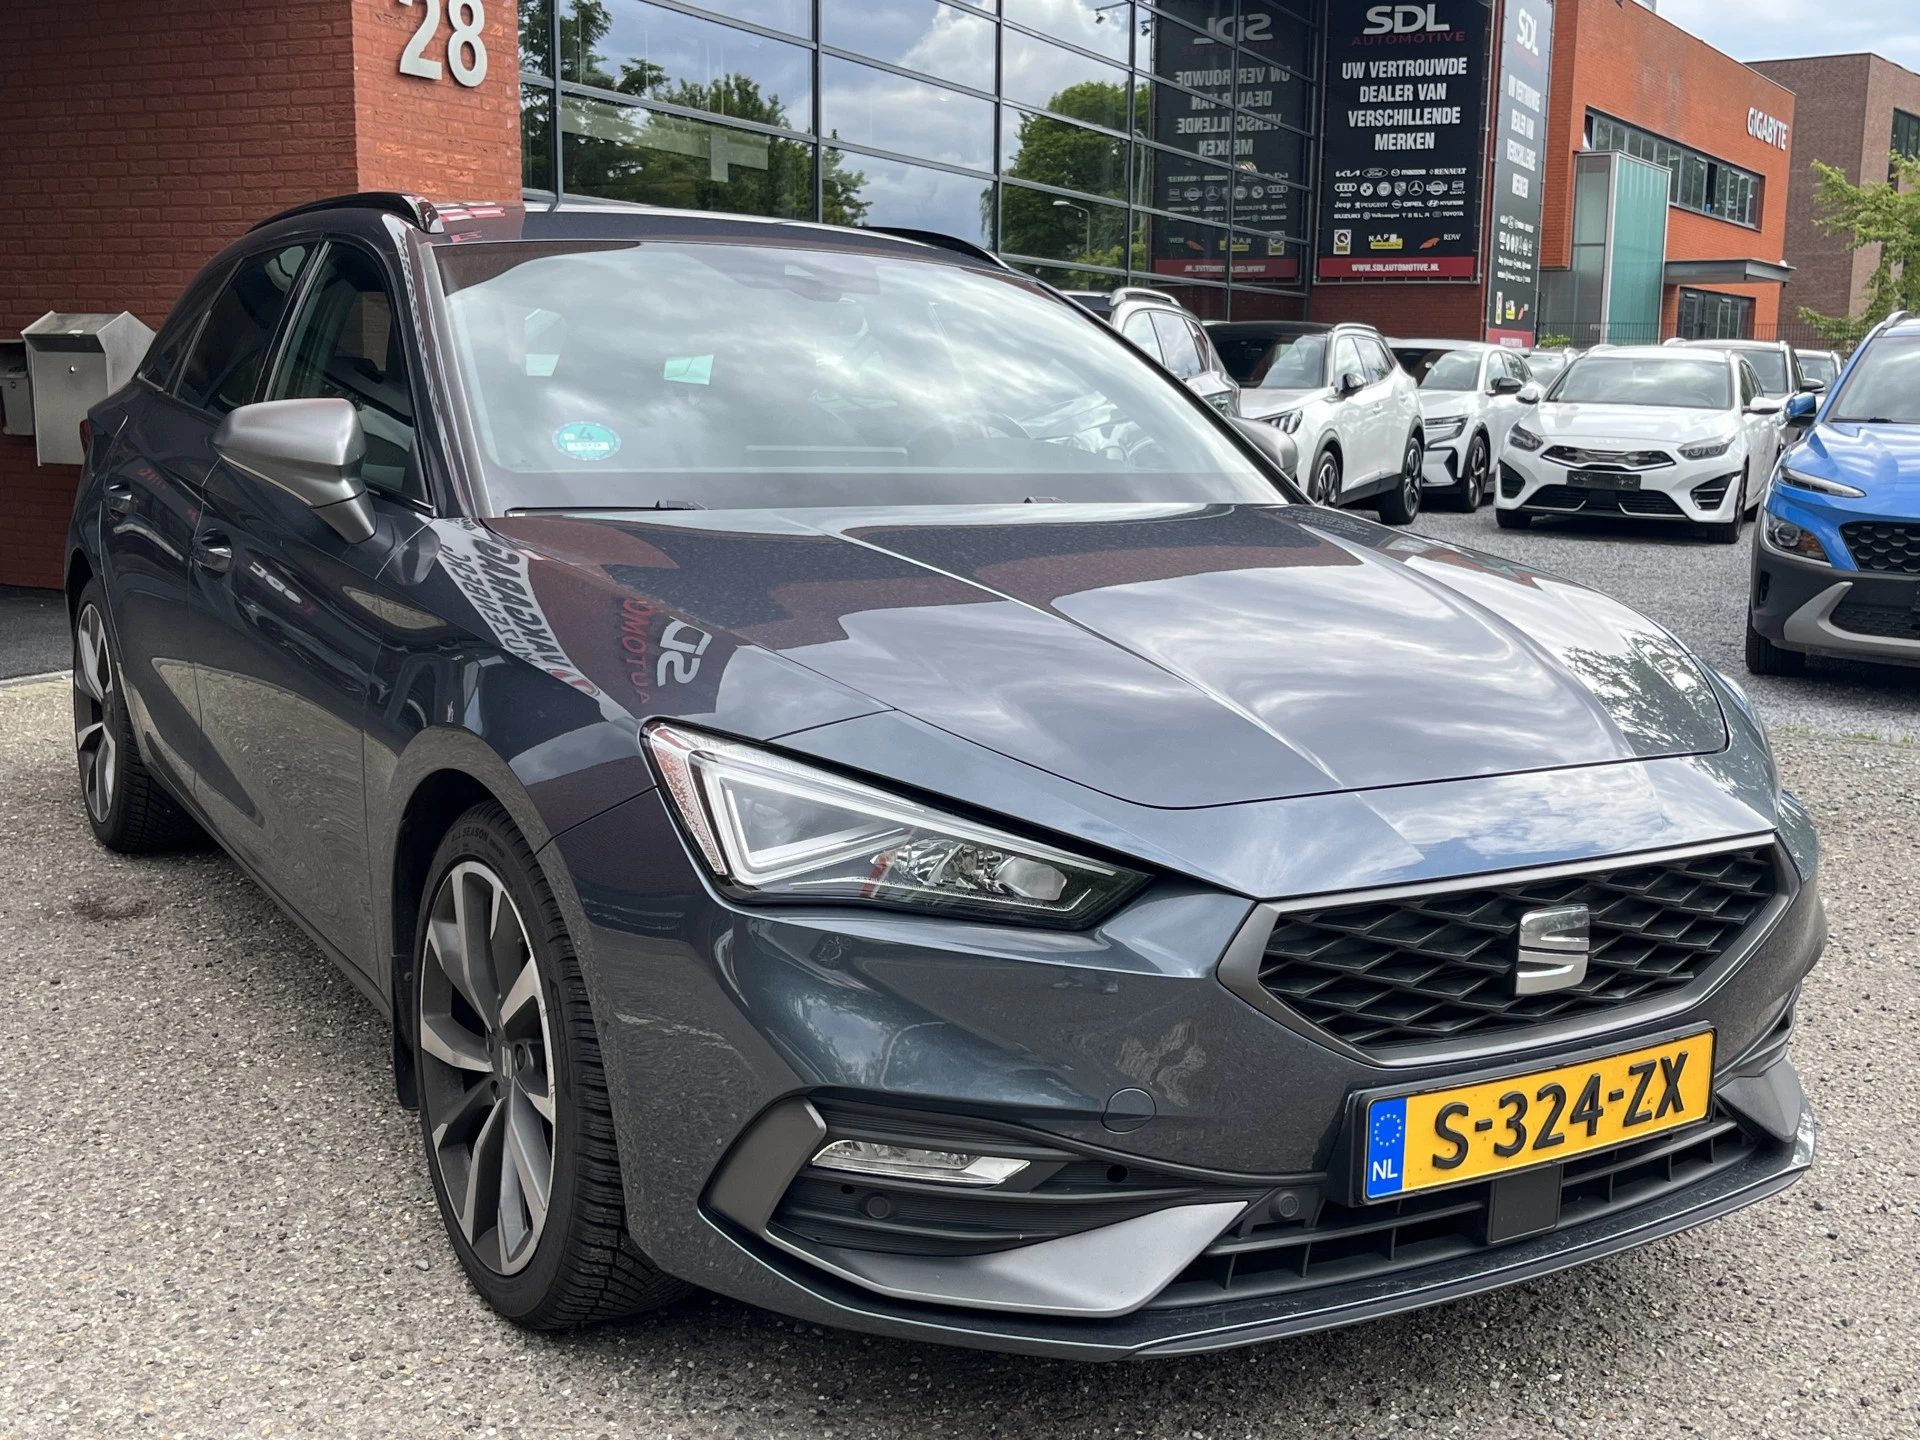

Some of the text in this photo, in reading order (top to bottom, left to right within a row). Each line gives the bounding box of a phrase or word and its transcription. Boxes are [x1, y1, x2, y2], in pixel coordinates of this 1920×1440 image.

[1362, 4, 1450, 35] SDL
[1352, 31, 1466, 46] AUTOMOTIVE
[1516, 8, 1539, 56] SDL
[399, 0, 488, 87] 28
[1342, 57, 1468, 79] UW VERTROUWDE
[1360, 83, 1447, 102] DEALER VAN
[1348, 107, 1461, 127] VERSCHILLENDE
[1747, 107, 1788, 151] GIGABYTE
[1374, 132, 1435, 151] MERKEN
[1434, 167, 1467, 176] RENAULT
[1334, 201, 1351, 209] Jeep
[1443, 233, 1461, 241] RDW
[1351, 263, 1439, 272] WWW.SDLAUTOMOTIVE.NL
[462, 826, 489, 843] SEASON
[1432, 1051, 1689, 1170] S-324-ZX
[1372, 1159, 1398, 1182] NL
